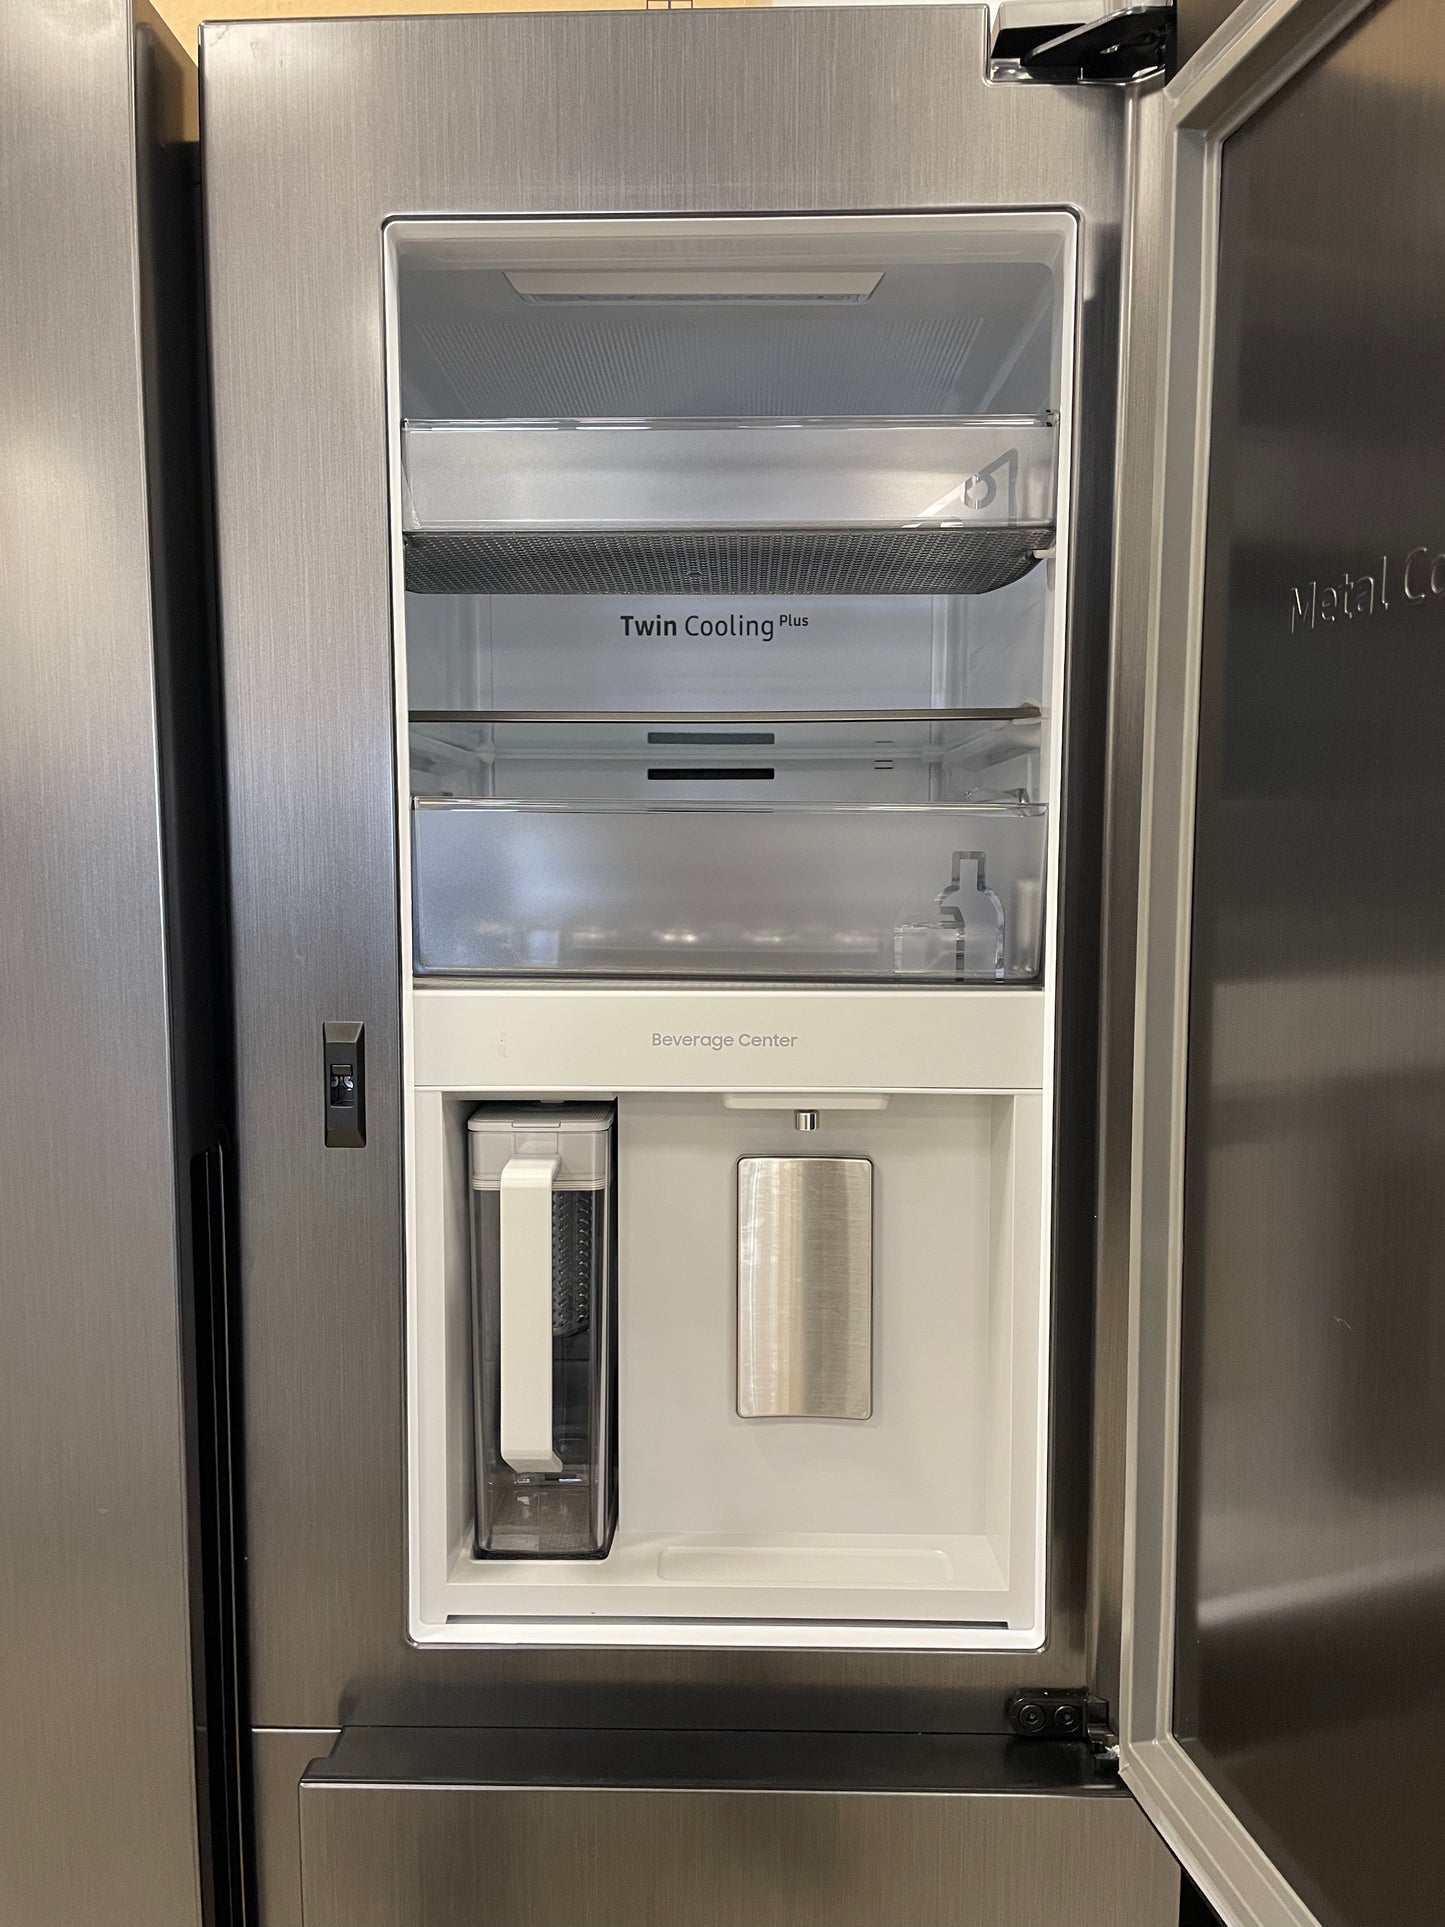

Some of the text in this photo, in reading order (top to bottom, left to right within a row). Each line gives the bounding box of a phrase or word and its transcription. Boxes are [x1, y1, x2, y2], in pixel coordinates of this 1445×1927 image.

[1290, 556, 1388, 634] Metal
[620, 614, 809, 642] Twin Cooling Plus
[652, 1032, 798, 1051] Beverage Center
